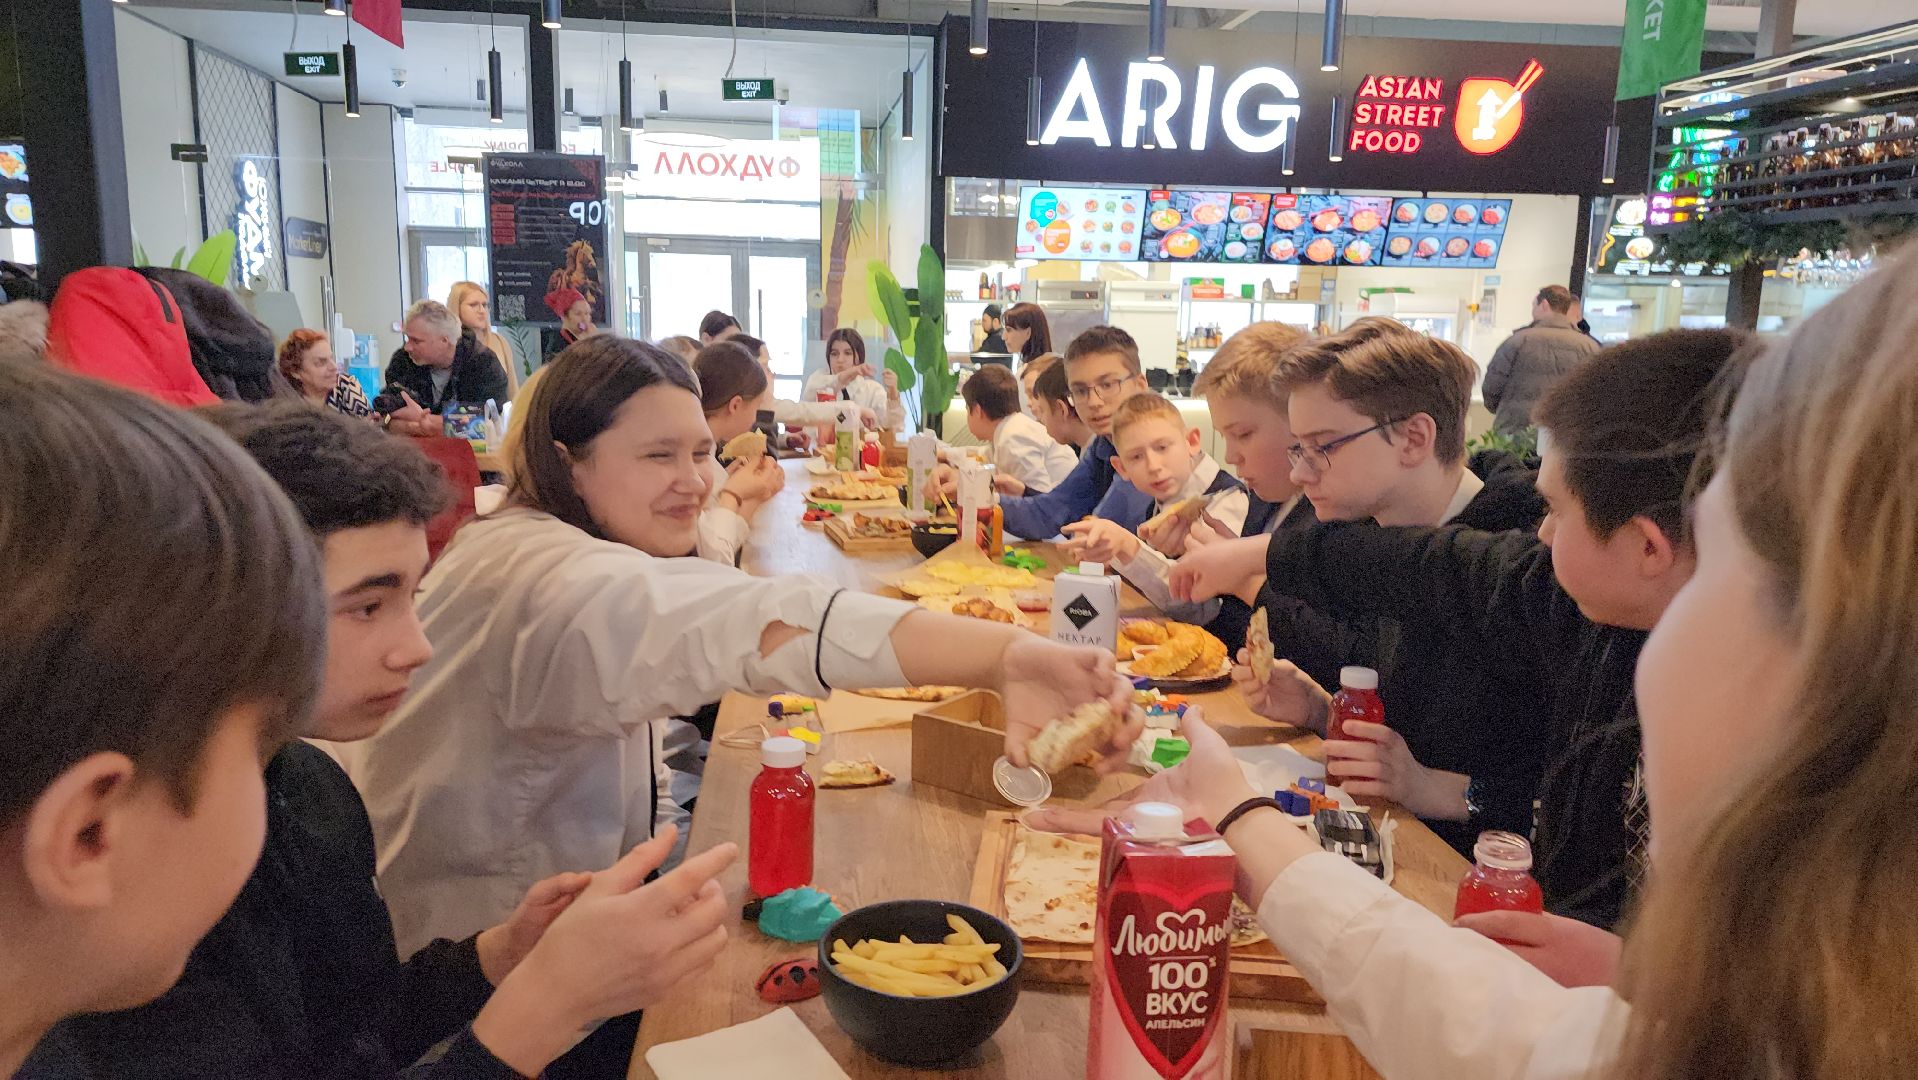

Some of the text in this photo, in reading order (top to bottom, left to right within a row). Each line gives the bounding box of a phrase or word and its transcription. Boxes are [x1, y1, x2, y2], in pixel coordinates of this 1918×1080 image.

[298, 56, 325, 66] ВЫХОД
[304, 65, 320, 73] EXIT
[735, 81, 761, 91] ВЫХОД
[741, 90, 757, 98] EXIT
[1359, 75, 1443, 99] ASIAN
[1040, 57, 1300, 153] ARIG
[1354, 103, 1446, 127] STREET
[1349, 130, 1422, 153] FOOD
[1145, 990, 1209, 1015] ВКУС
[1145, 1018, 1206, 1030] АПЕЛЬСИН
